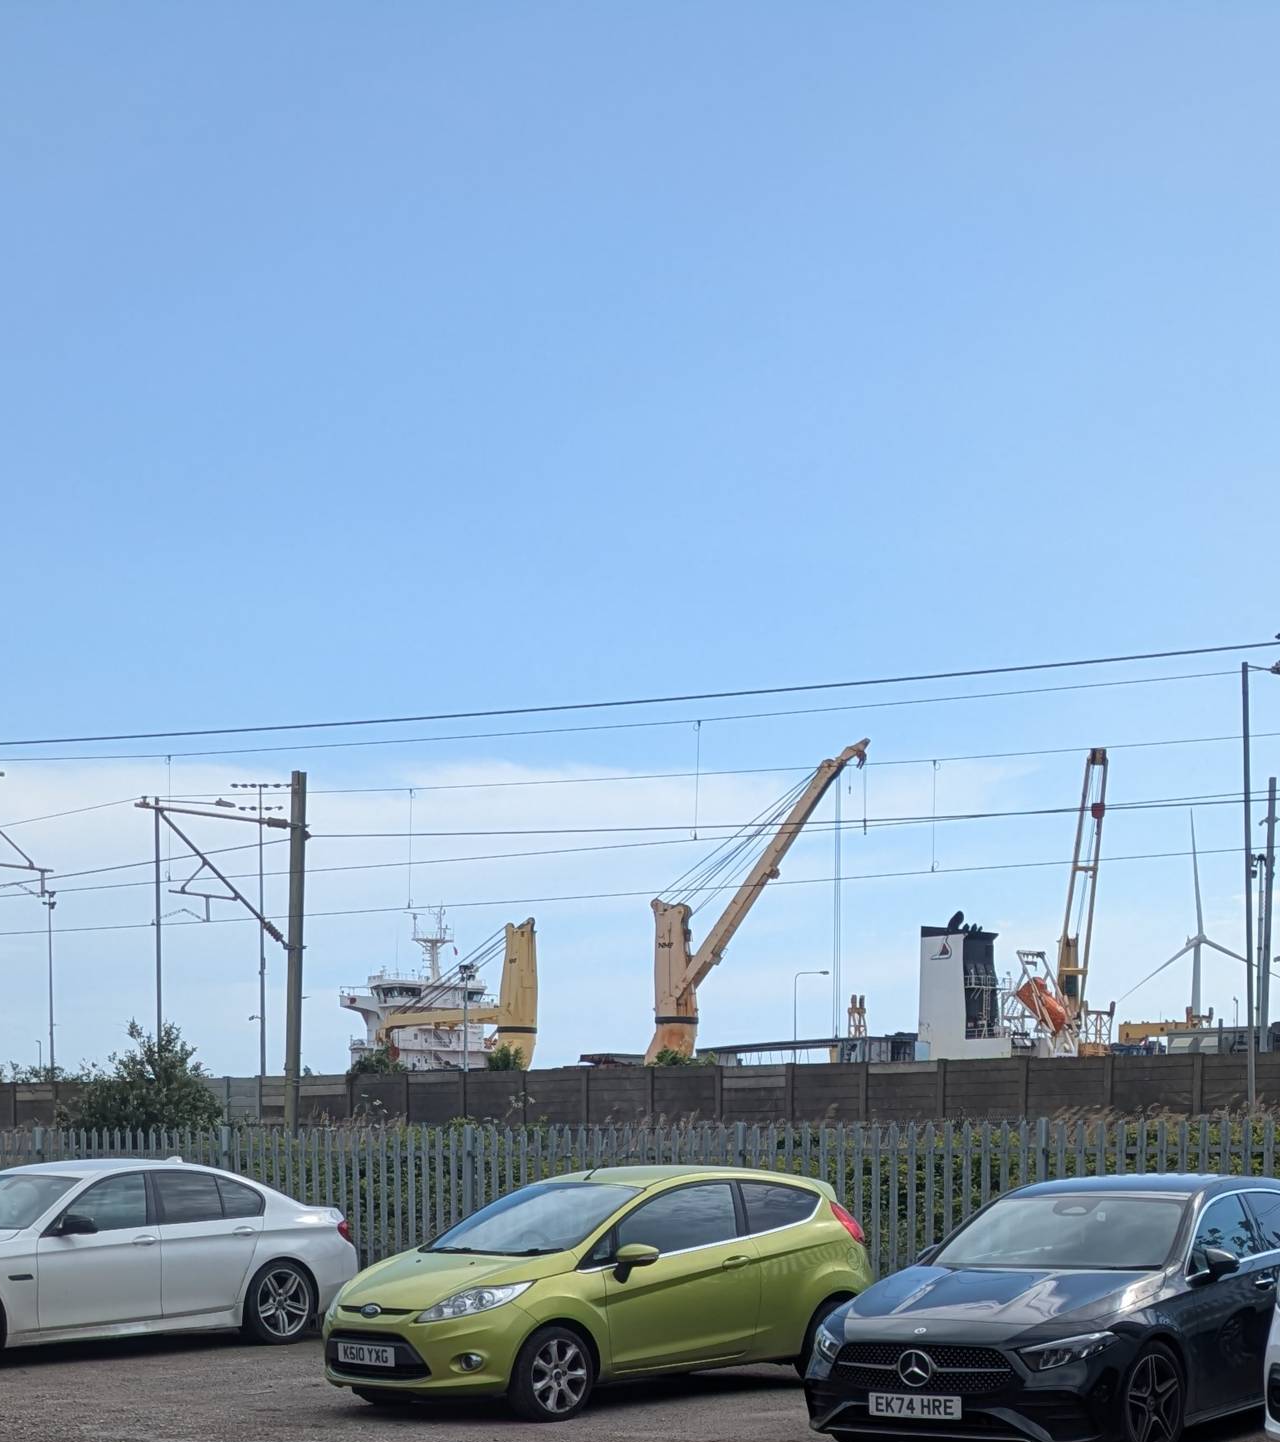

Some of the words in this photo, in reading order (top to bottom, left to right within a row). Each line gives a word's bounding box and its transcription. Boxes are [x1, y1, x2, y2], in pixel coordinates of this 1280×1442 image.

[343, 1345, 365, 1361] KS10
[367, 1347, 389, 1364] YXG
[875, 1396, 916, 1415] EK74
[921, 1398, 955, 1416] HRE
